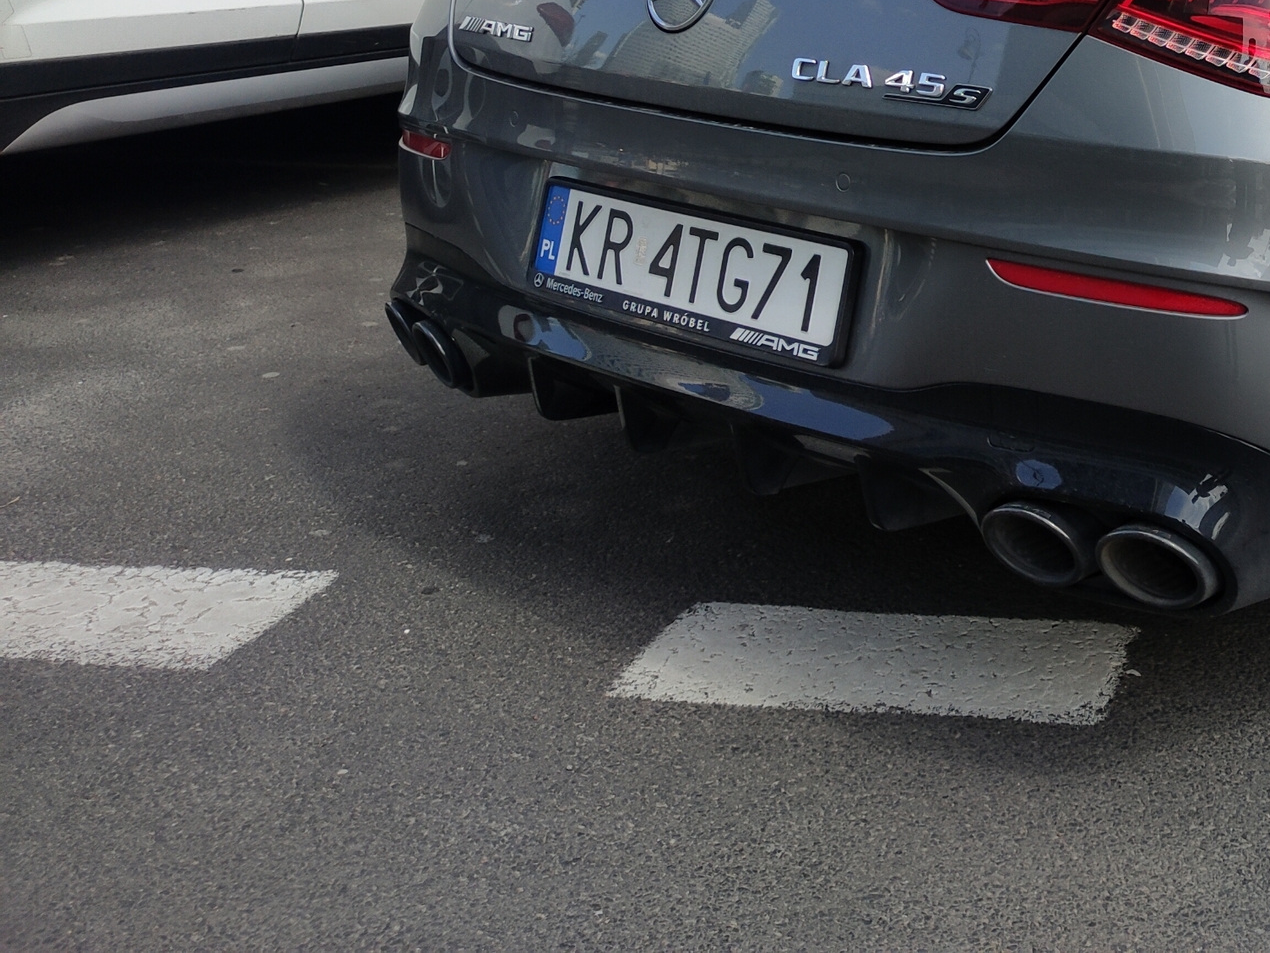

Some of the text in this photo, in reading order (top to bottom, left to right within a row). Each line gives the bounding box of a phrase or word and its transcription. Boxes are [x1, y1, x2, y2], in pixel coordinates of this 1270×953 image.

[476, 18, 534, 43] AMG
[791, 57, 982, 105] CLA 45 S
[540, 238, 556, 261] PL
[565, 199, 822, 334] KR 4TG71
[546, 277, 604, 304] Mercedes-Benz
[622, 300, 711, 333] GRUPA WRÓBEL
[757, 333, 823, 362] AMG
